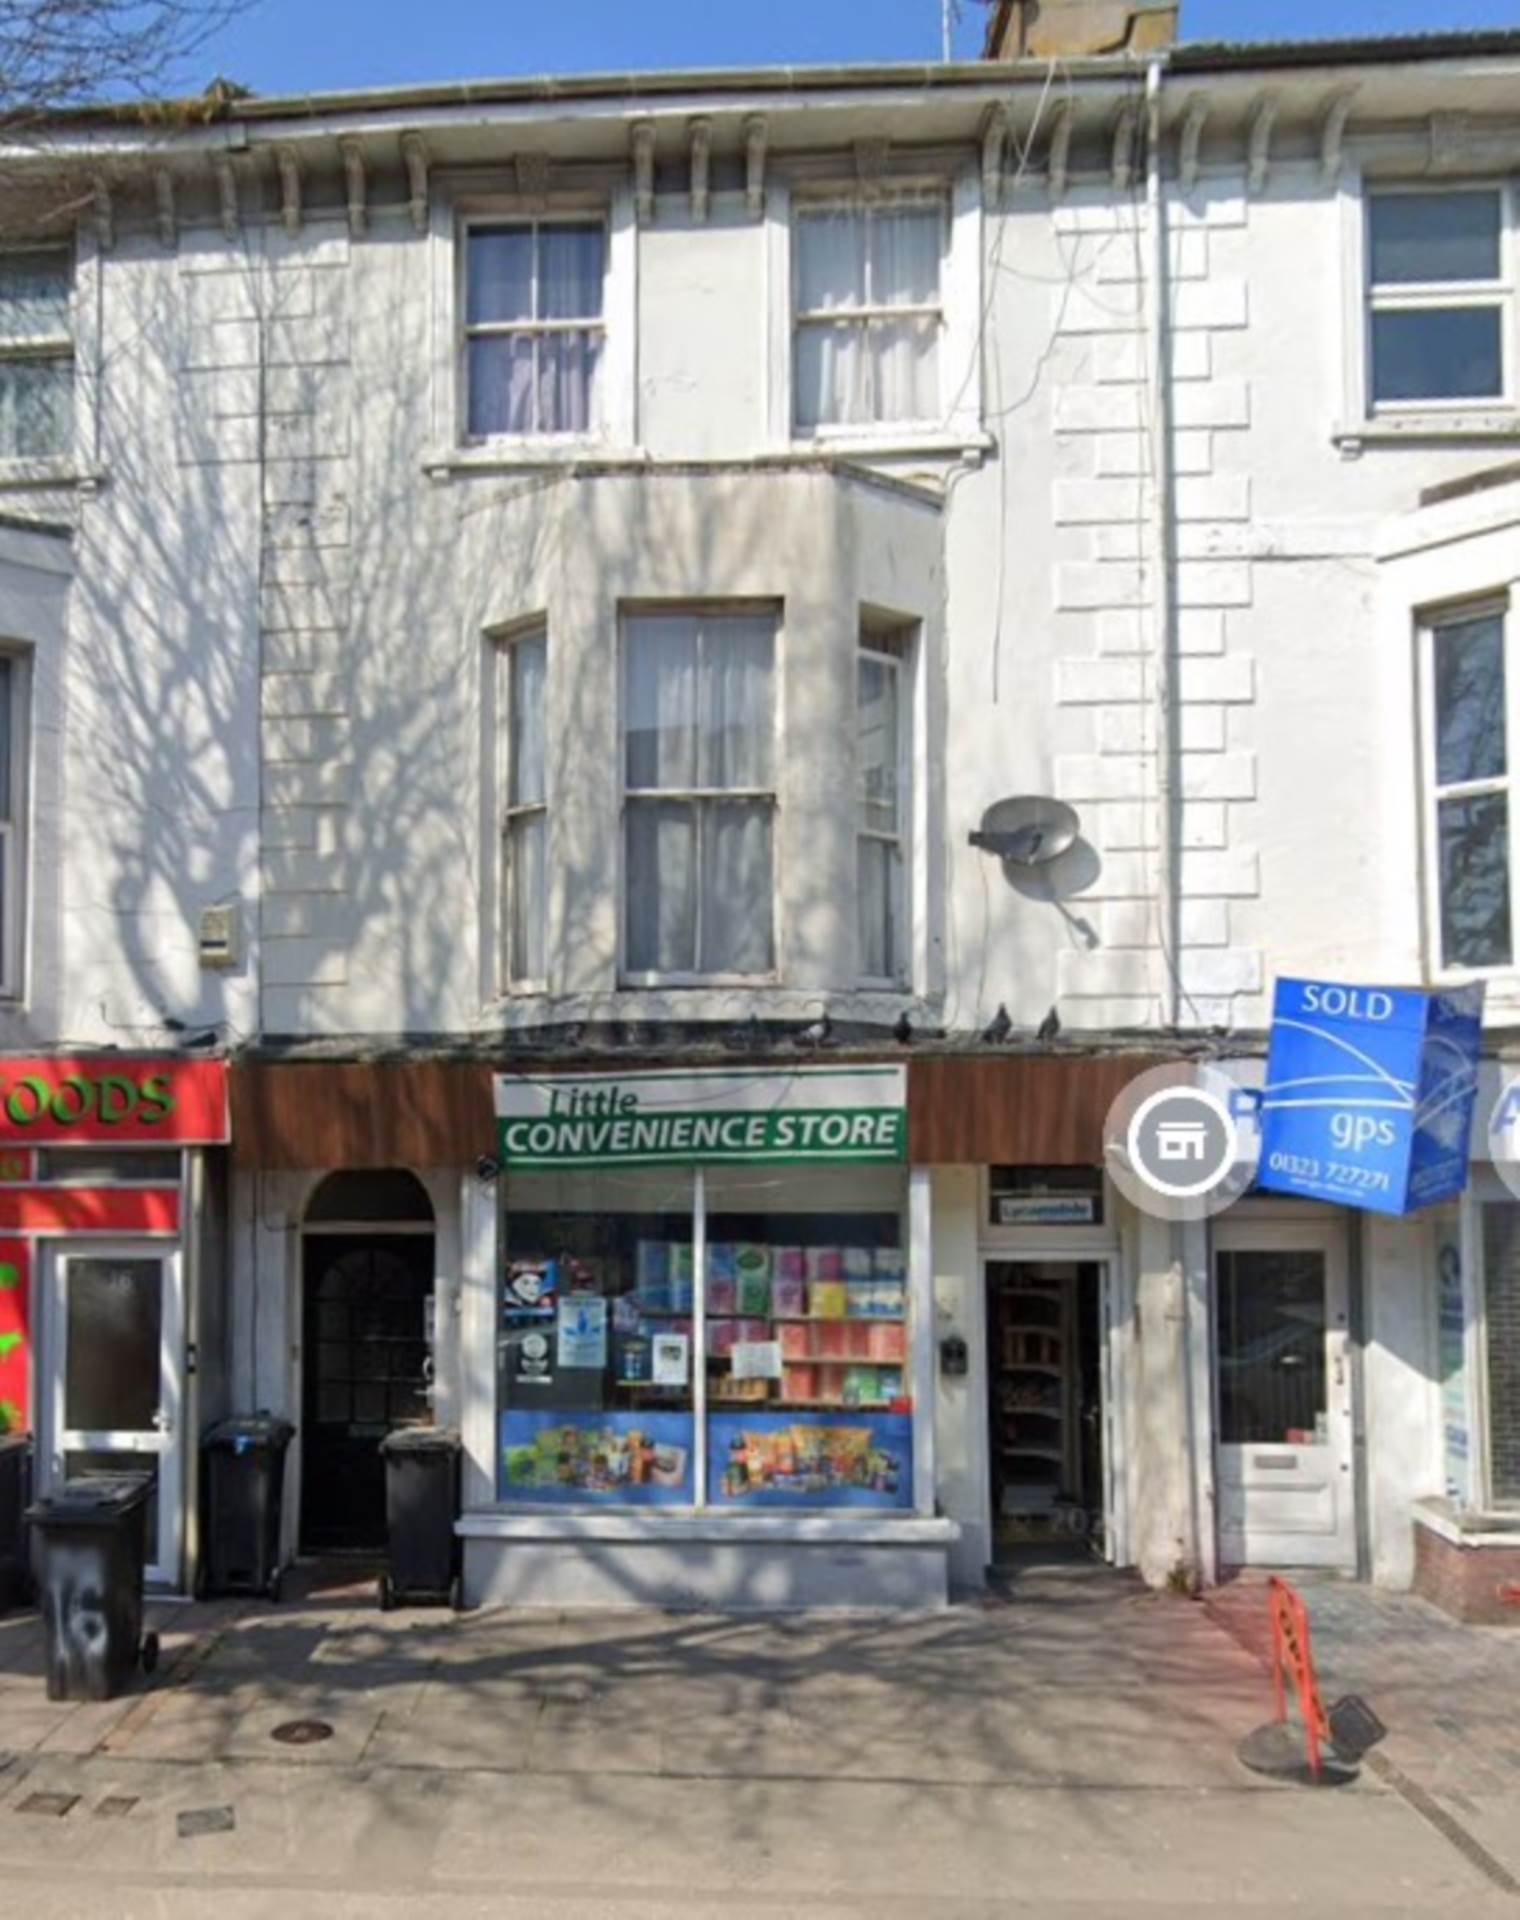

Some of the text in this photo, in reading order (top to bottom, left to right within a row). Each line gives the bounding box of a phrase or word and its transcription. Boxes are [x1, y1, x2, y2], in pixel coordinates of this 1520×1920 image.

[1302, 984, 1393, 1020] SOLD
[0, 1072, 176, 1125] OODS
[549, 1086, 639, 1117] Little
[505, 1114, 900, 1153] CONVENIENCE STORE
[1330, 1113, 1396, 1152] gps
[1268, 1152, 1320, 1179] 01323
